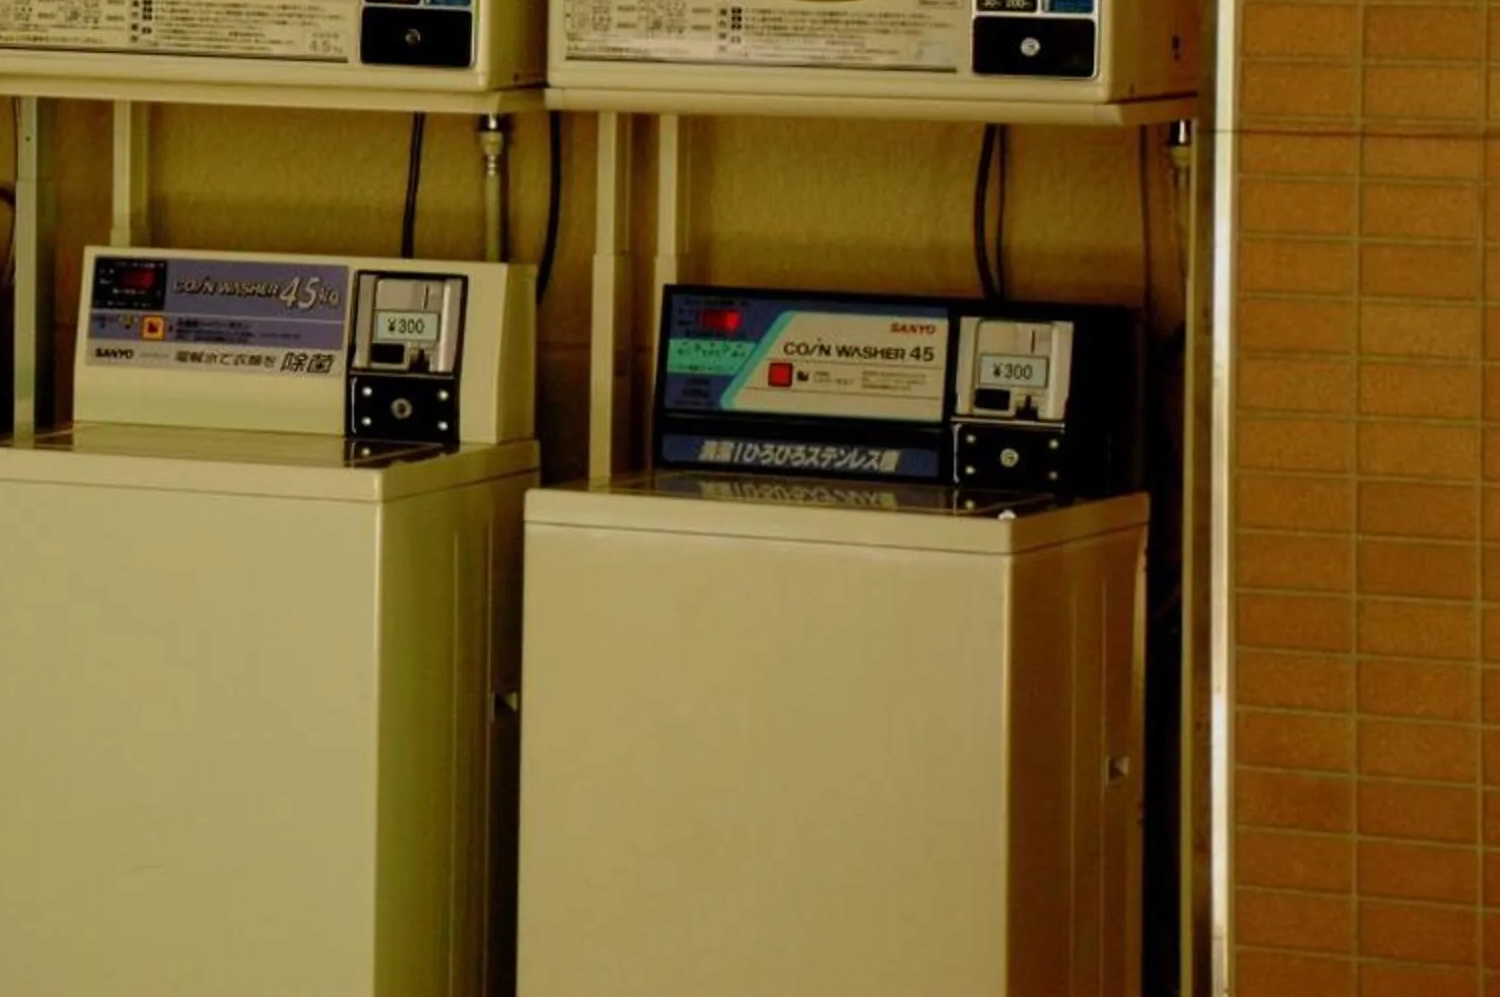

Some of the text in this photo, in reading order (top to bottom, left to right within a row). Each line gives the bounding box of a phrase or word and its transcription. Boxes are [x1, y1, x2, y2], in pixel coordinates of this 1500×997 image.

[388, 317, 425, 334] ¥300
[890, 322, 936, 336] SANYO
[95, 348, 134, 360] SANYO
[784, 338, 935, 362] COIN WASHER 45
[992, 361, 1033, 380] ¥300
